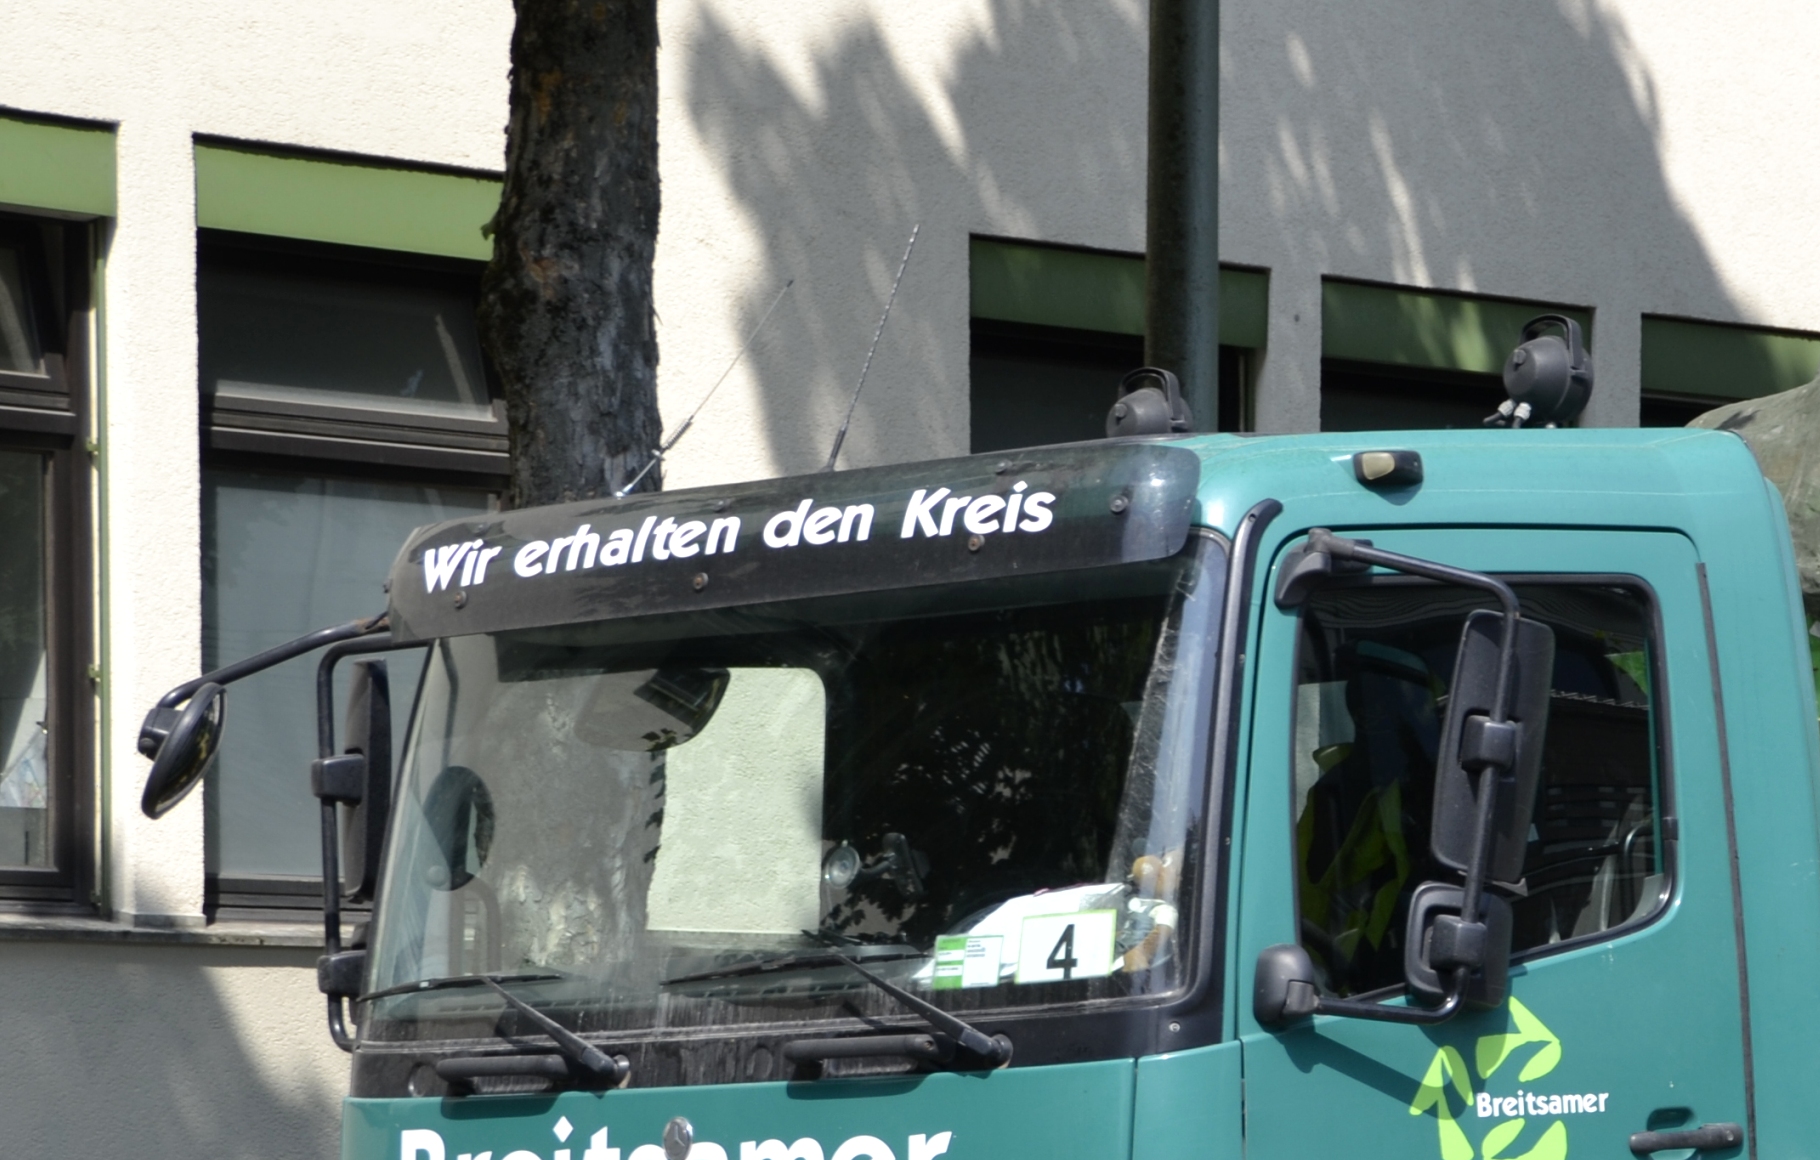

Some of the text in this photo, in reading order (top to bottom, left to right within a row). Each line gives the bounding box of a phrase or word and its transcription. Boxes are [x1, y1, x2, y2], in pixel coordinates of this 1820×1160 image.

[423, 480, 1056, 594] Wir erhalten den Kreis
[1045, 924, 1078, 980] 4
[1476, 1089, 1609, 1118] Breitsamer
